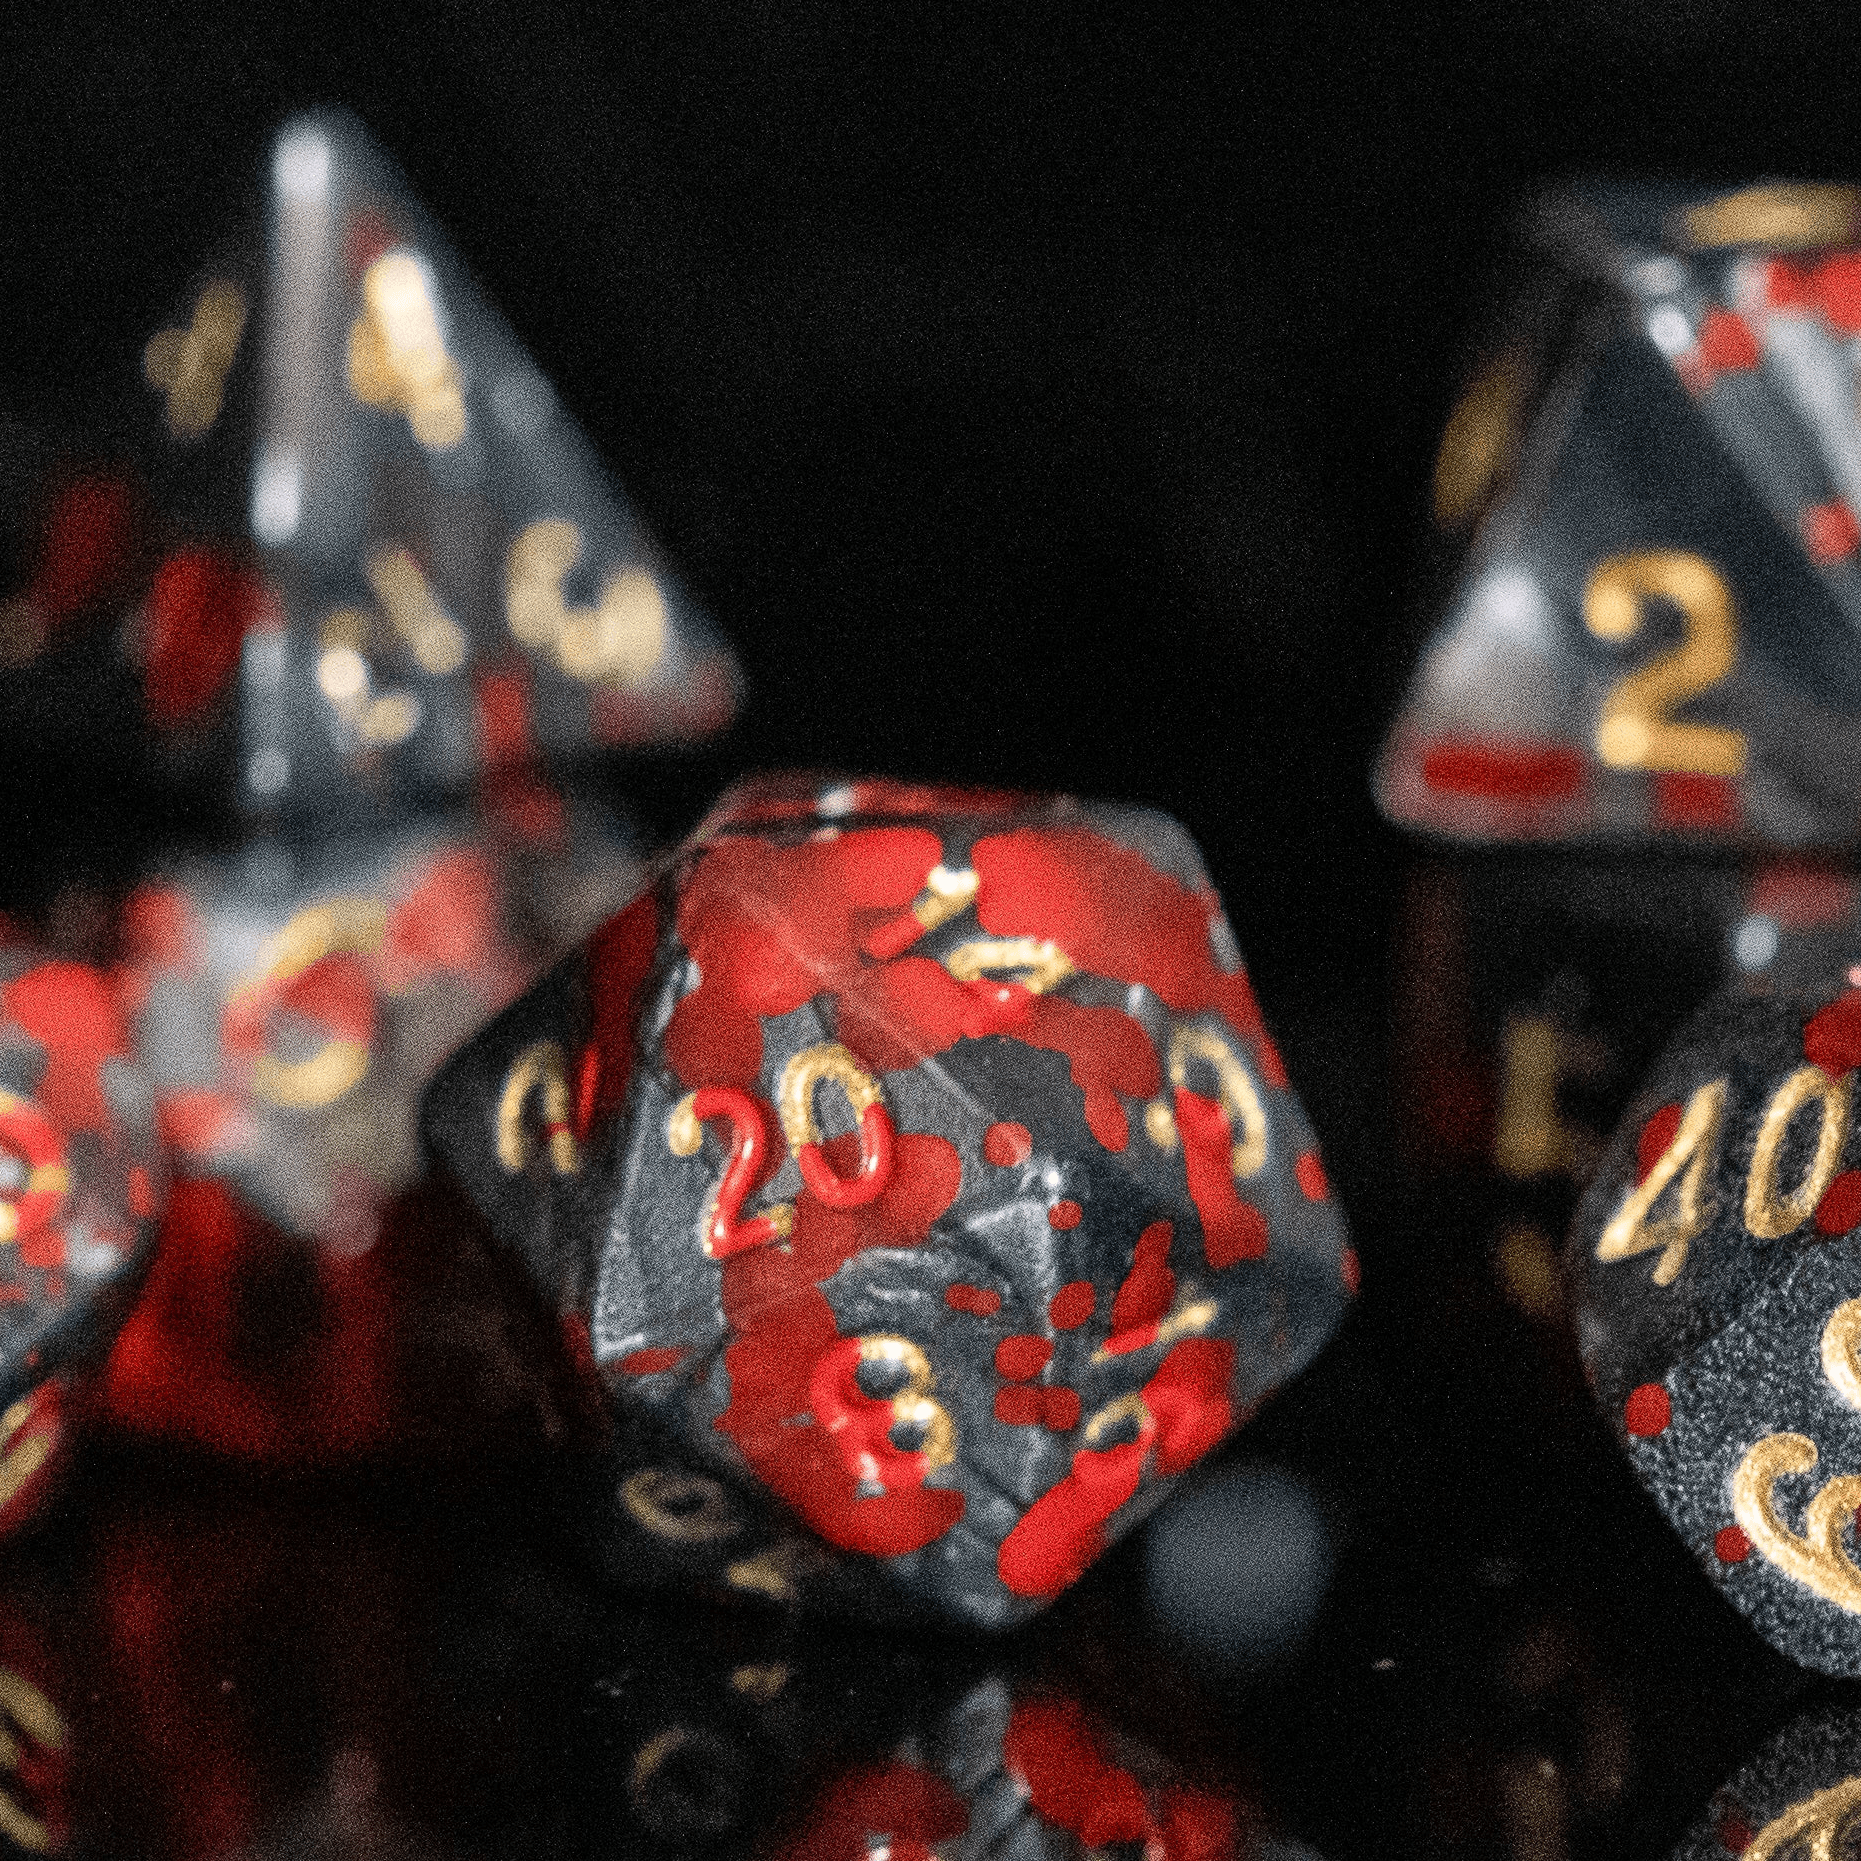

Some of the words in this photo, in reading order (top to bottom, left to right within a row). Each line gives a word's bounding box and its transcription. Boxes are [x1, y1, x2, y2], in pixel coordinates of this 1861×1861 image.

[1584, 548, 1747, 777] 2
[666, 1042, 897, 1260] 20
[1597, 1064, 1853, 1286] 40
[810, 1333, 958, 1490] 8
